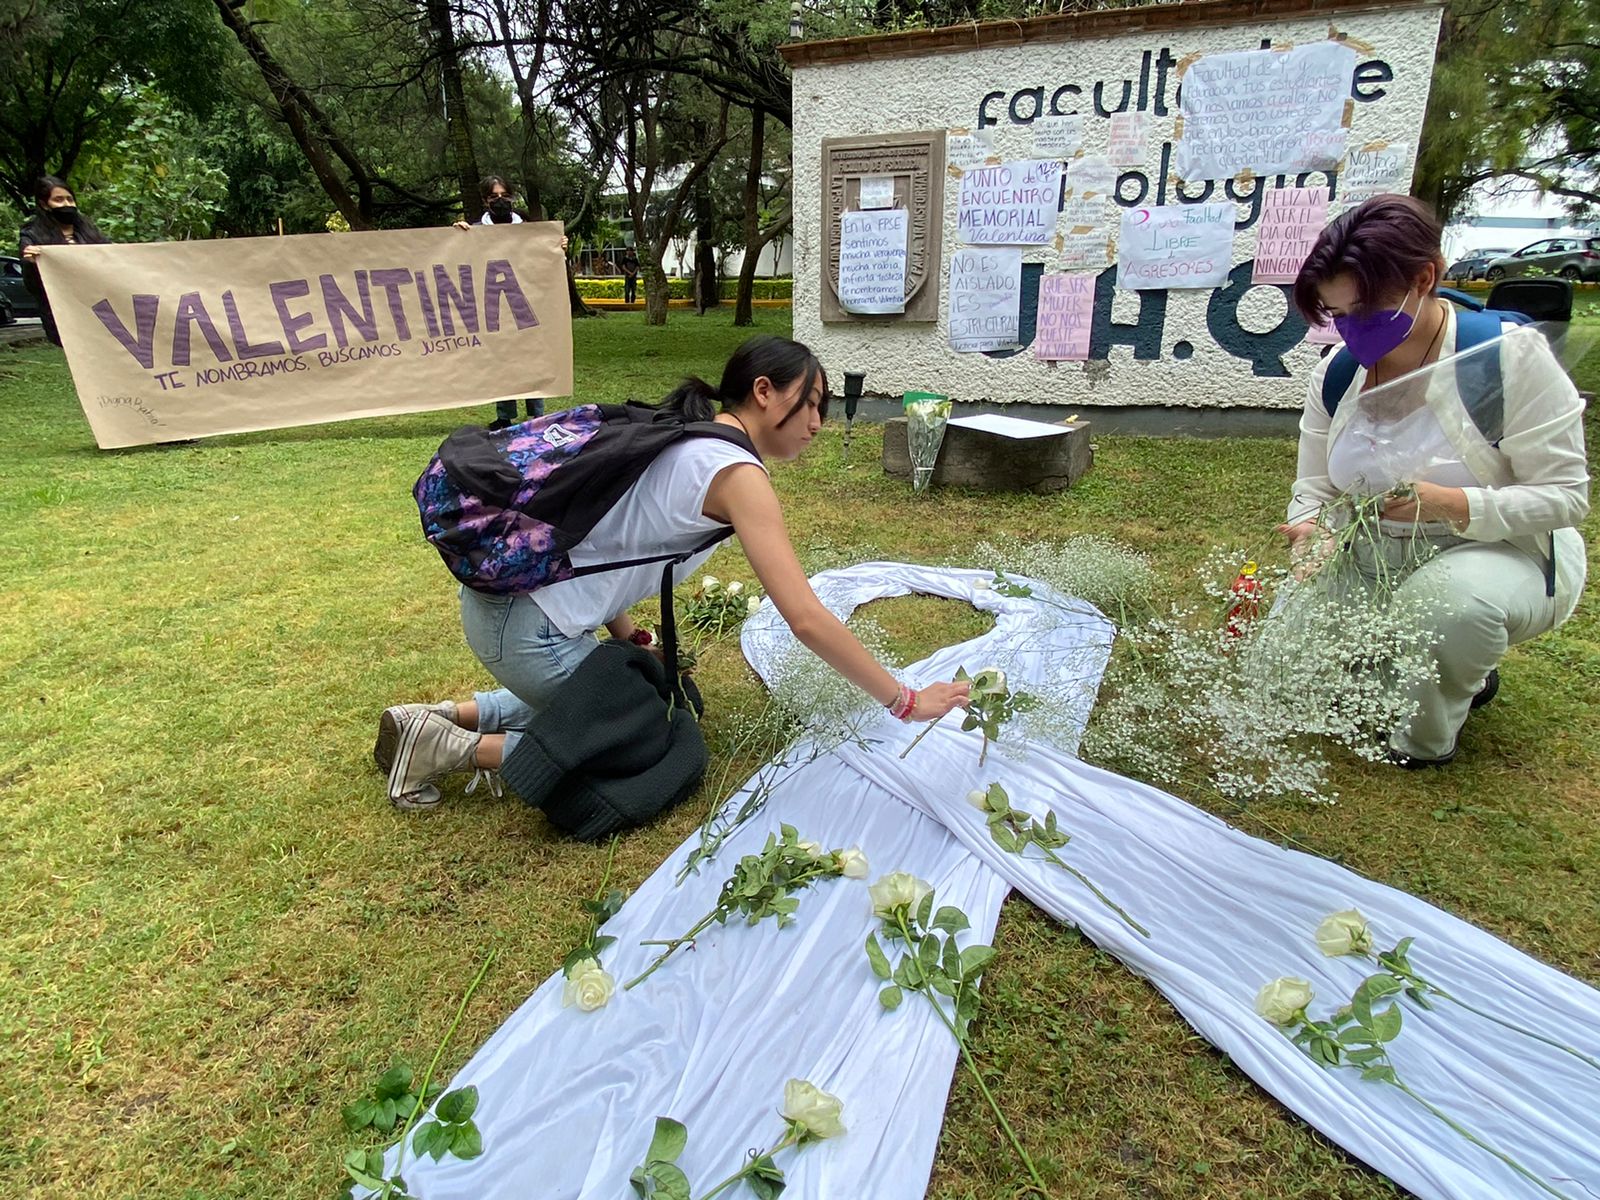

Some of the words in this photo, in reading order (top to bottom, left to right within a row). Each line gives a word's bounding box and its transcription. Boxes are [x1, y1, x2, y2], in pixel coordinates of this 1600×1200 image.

[1193, 57, 1250, 82] Facultad
[1256, 59, 1272, 76] de
[1243, 79, 1266, 94] tus
[1270, 73, 1342, 91] estudiantes
[1318, 89, 1338, 103] NO
[1233, 111, 1266, 123] como
[1270, 105, 1322, 119] ustedes
[1296, 119, 1312, 132] de
[1241, 140, 1256, 152] se
[1259, 137, 1302, 153] quieren
[1350, 150, 1371, 166] NOS
[963, 168, 1012, 188] PUNTO
[1022, 168, 1036, 183] de
[961, 188, 1055, 206] ENCUENTRO
[1264, 190, 1300, 207] FELIZ
[1308, 189, 1321, 207] VA
[959, 208, 1045, 229] MEMORIAL
[1262, 210, 1270, 224] A
[1271, 208, 1296, 224] SER
[1300, 208, 1315, 223] EL
[844, 218, 858, 233] En
[862, 219, 872, 232] la
[879, 216, 902, 231] FPSE
[969, 228, 1049, 243] Valentina
[1144, 229, 1201, 251] LIBRE
[1259, 226, 1280, 241] DIA
[1284, 225, 1306, 241] QUE
[1258, 241, 1276, 256] NO
[842, 263, 870, 272] mucha
[953, 254, 975, 275] NO
[982, 256, 999, 273] ES
[1123, 259, 1213, 279] AGRESORES
[843, 273, 874, 284] infinita
[1043, 279, 1062, 294] QUE
[1068, 278, 1088, 293] SER
[850, 286, 898, 295] nombramos
[1042, 296, 1080, 311] MUJER
[91, 260, 539, 369] VALENTINA
[1041, 313, 1057, 327] NO
[1060, 312, 1081, 327] NOS
[1039, 328, 1073, 342] CUESTE
[1039, 344, 1050, 358] LA
[1053, 343, 1078, 357] VIDA
[154, 371, 185, 391] TE
[319, 343, 401, 368] BUSCAMOS
[420, 336, 481, 357] JUSTICIA
